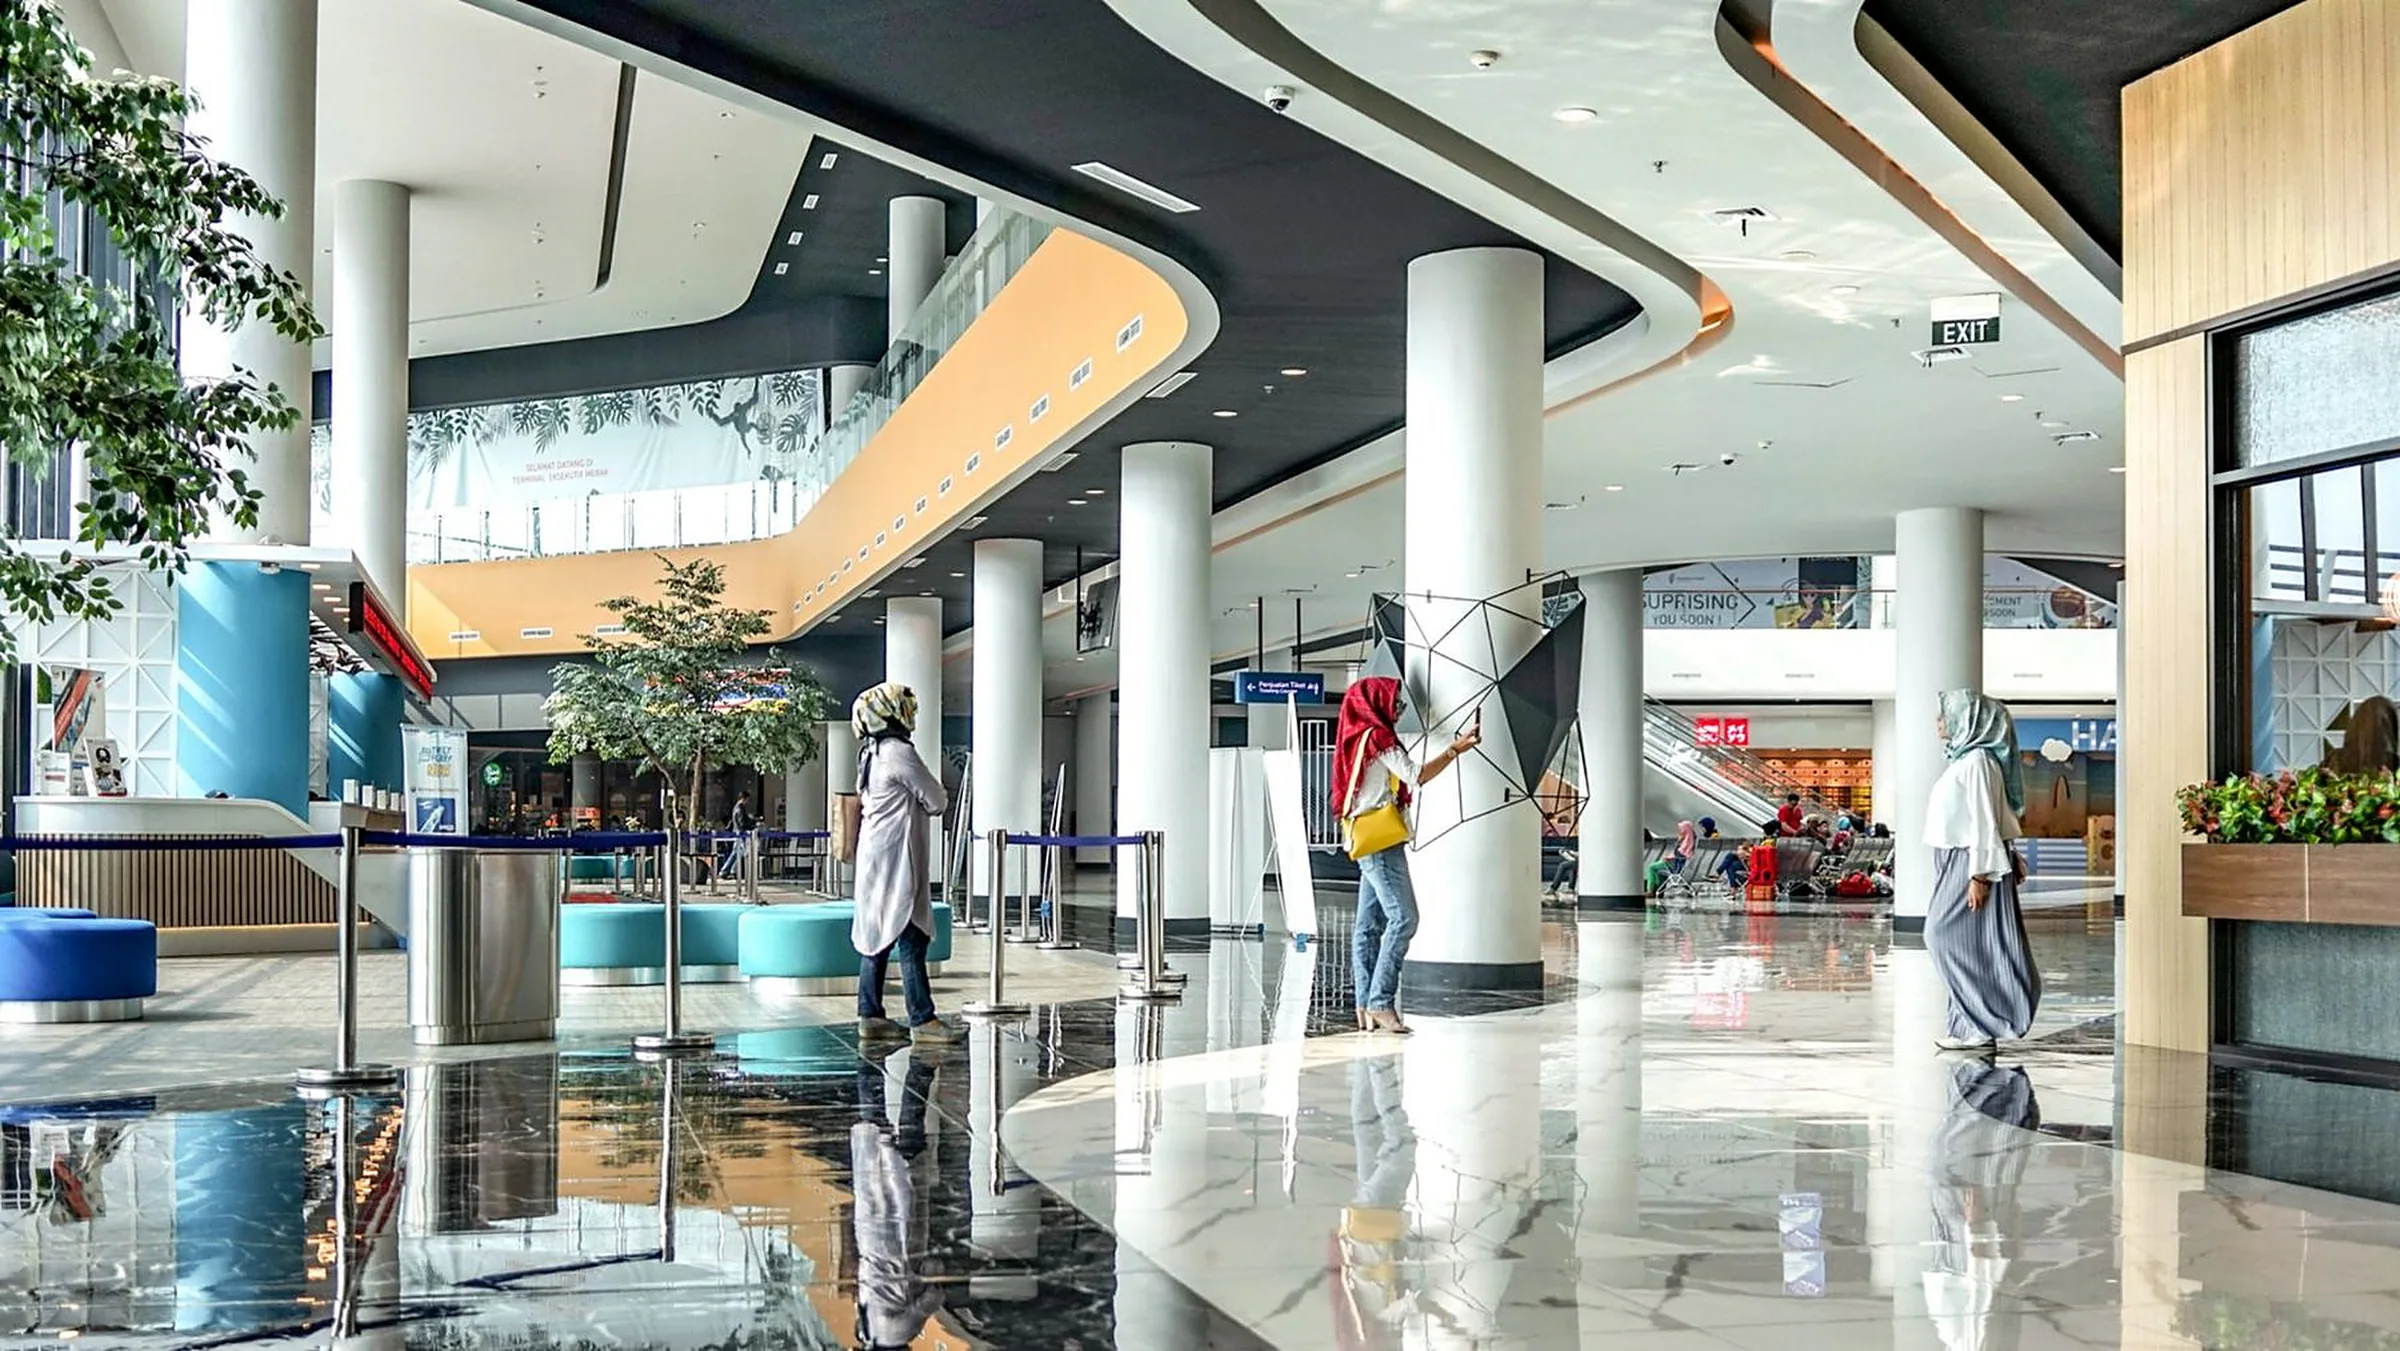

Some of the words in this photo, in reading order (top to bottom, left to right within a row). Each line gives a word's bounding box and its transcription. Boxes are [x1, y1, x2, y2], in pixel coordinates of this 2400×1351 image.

[1943, 320, 1988, 343] EXIT
[1652, 614, 1677, 625] YOU
[1680, 614, 1714, 625] SOON
